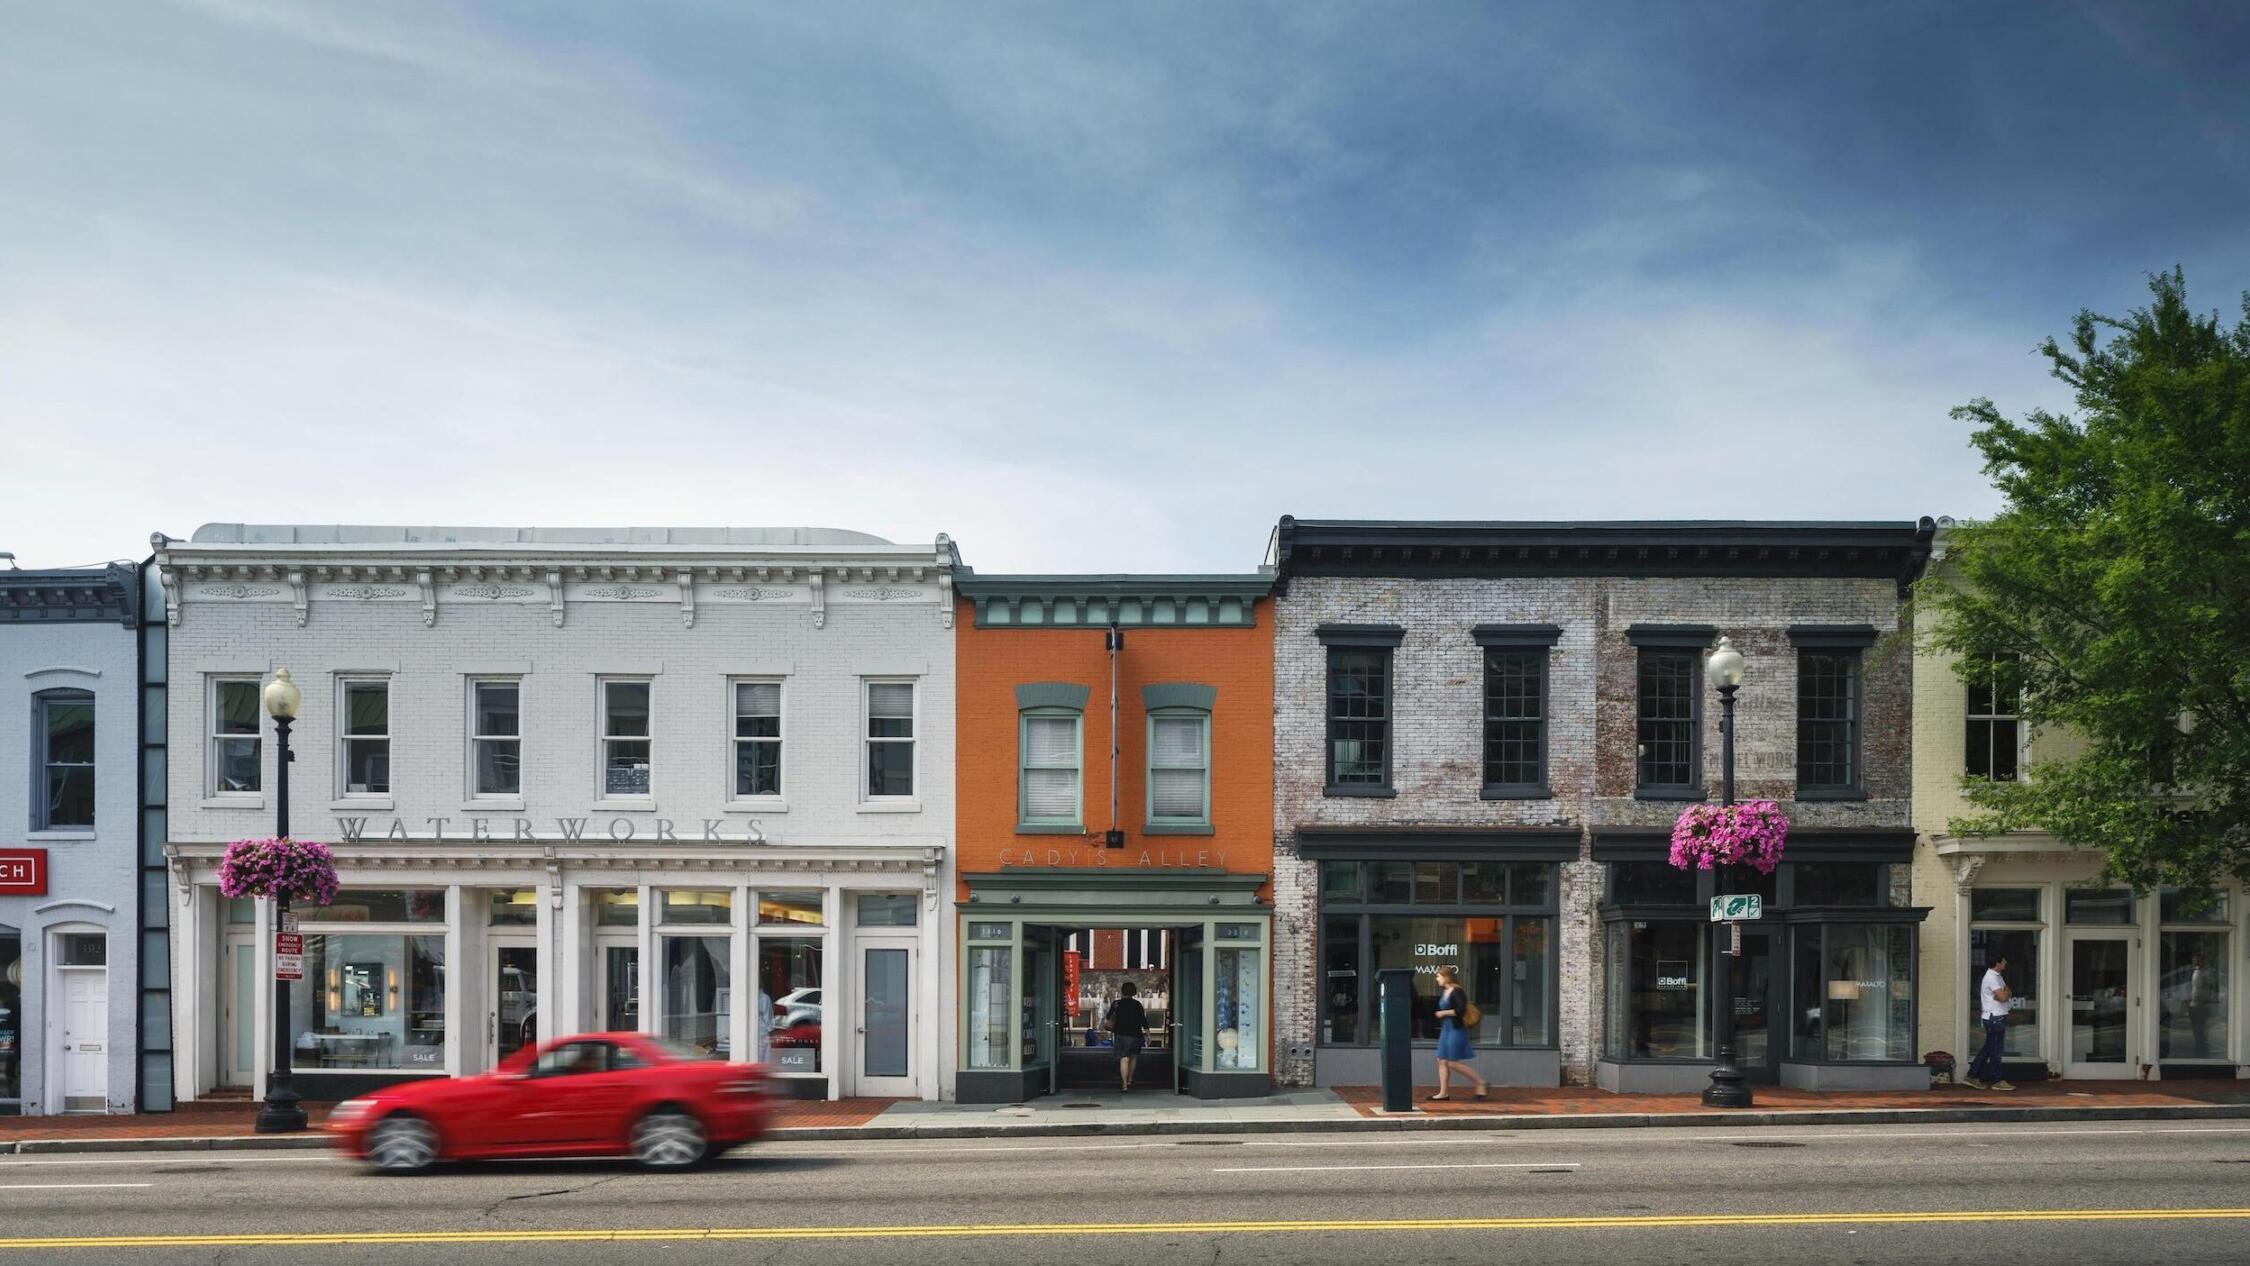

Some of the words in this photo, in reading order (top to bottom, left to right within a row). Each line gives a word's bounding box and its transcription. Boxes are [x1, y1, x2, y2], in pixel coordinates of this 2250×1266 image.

[335, 817, 763, 842] WATERWORKS
[1139, 851, 1227, 866] ALLEY
[1427, 944, 1458, 955] Boffi
[1666, 977, 1687, 985] Boffi
[781, 1056, 804, 1064] SALE
